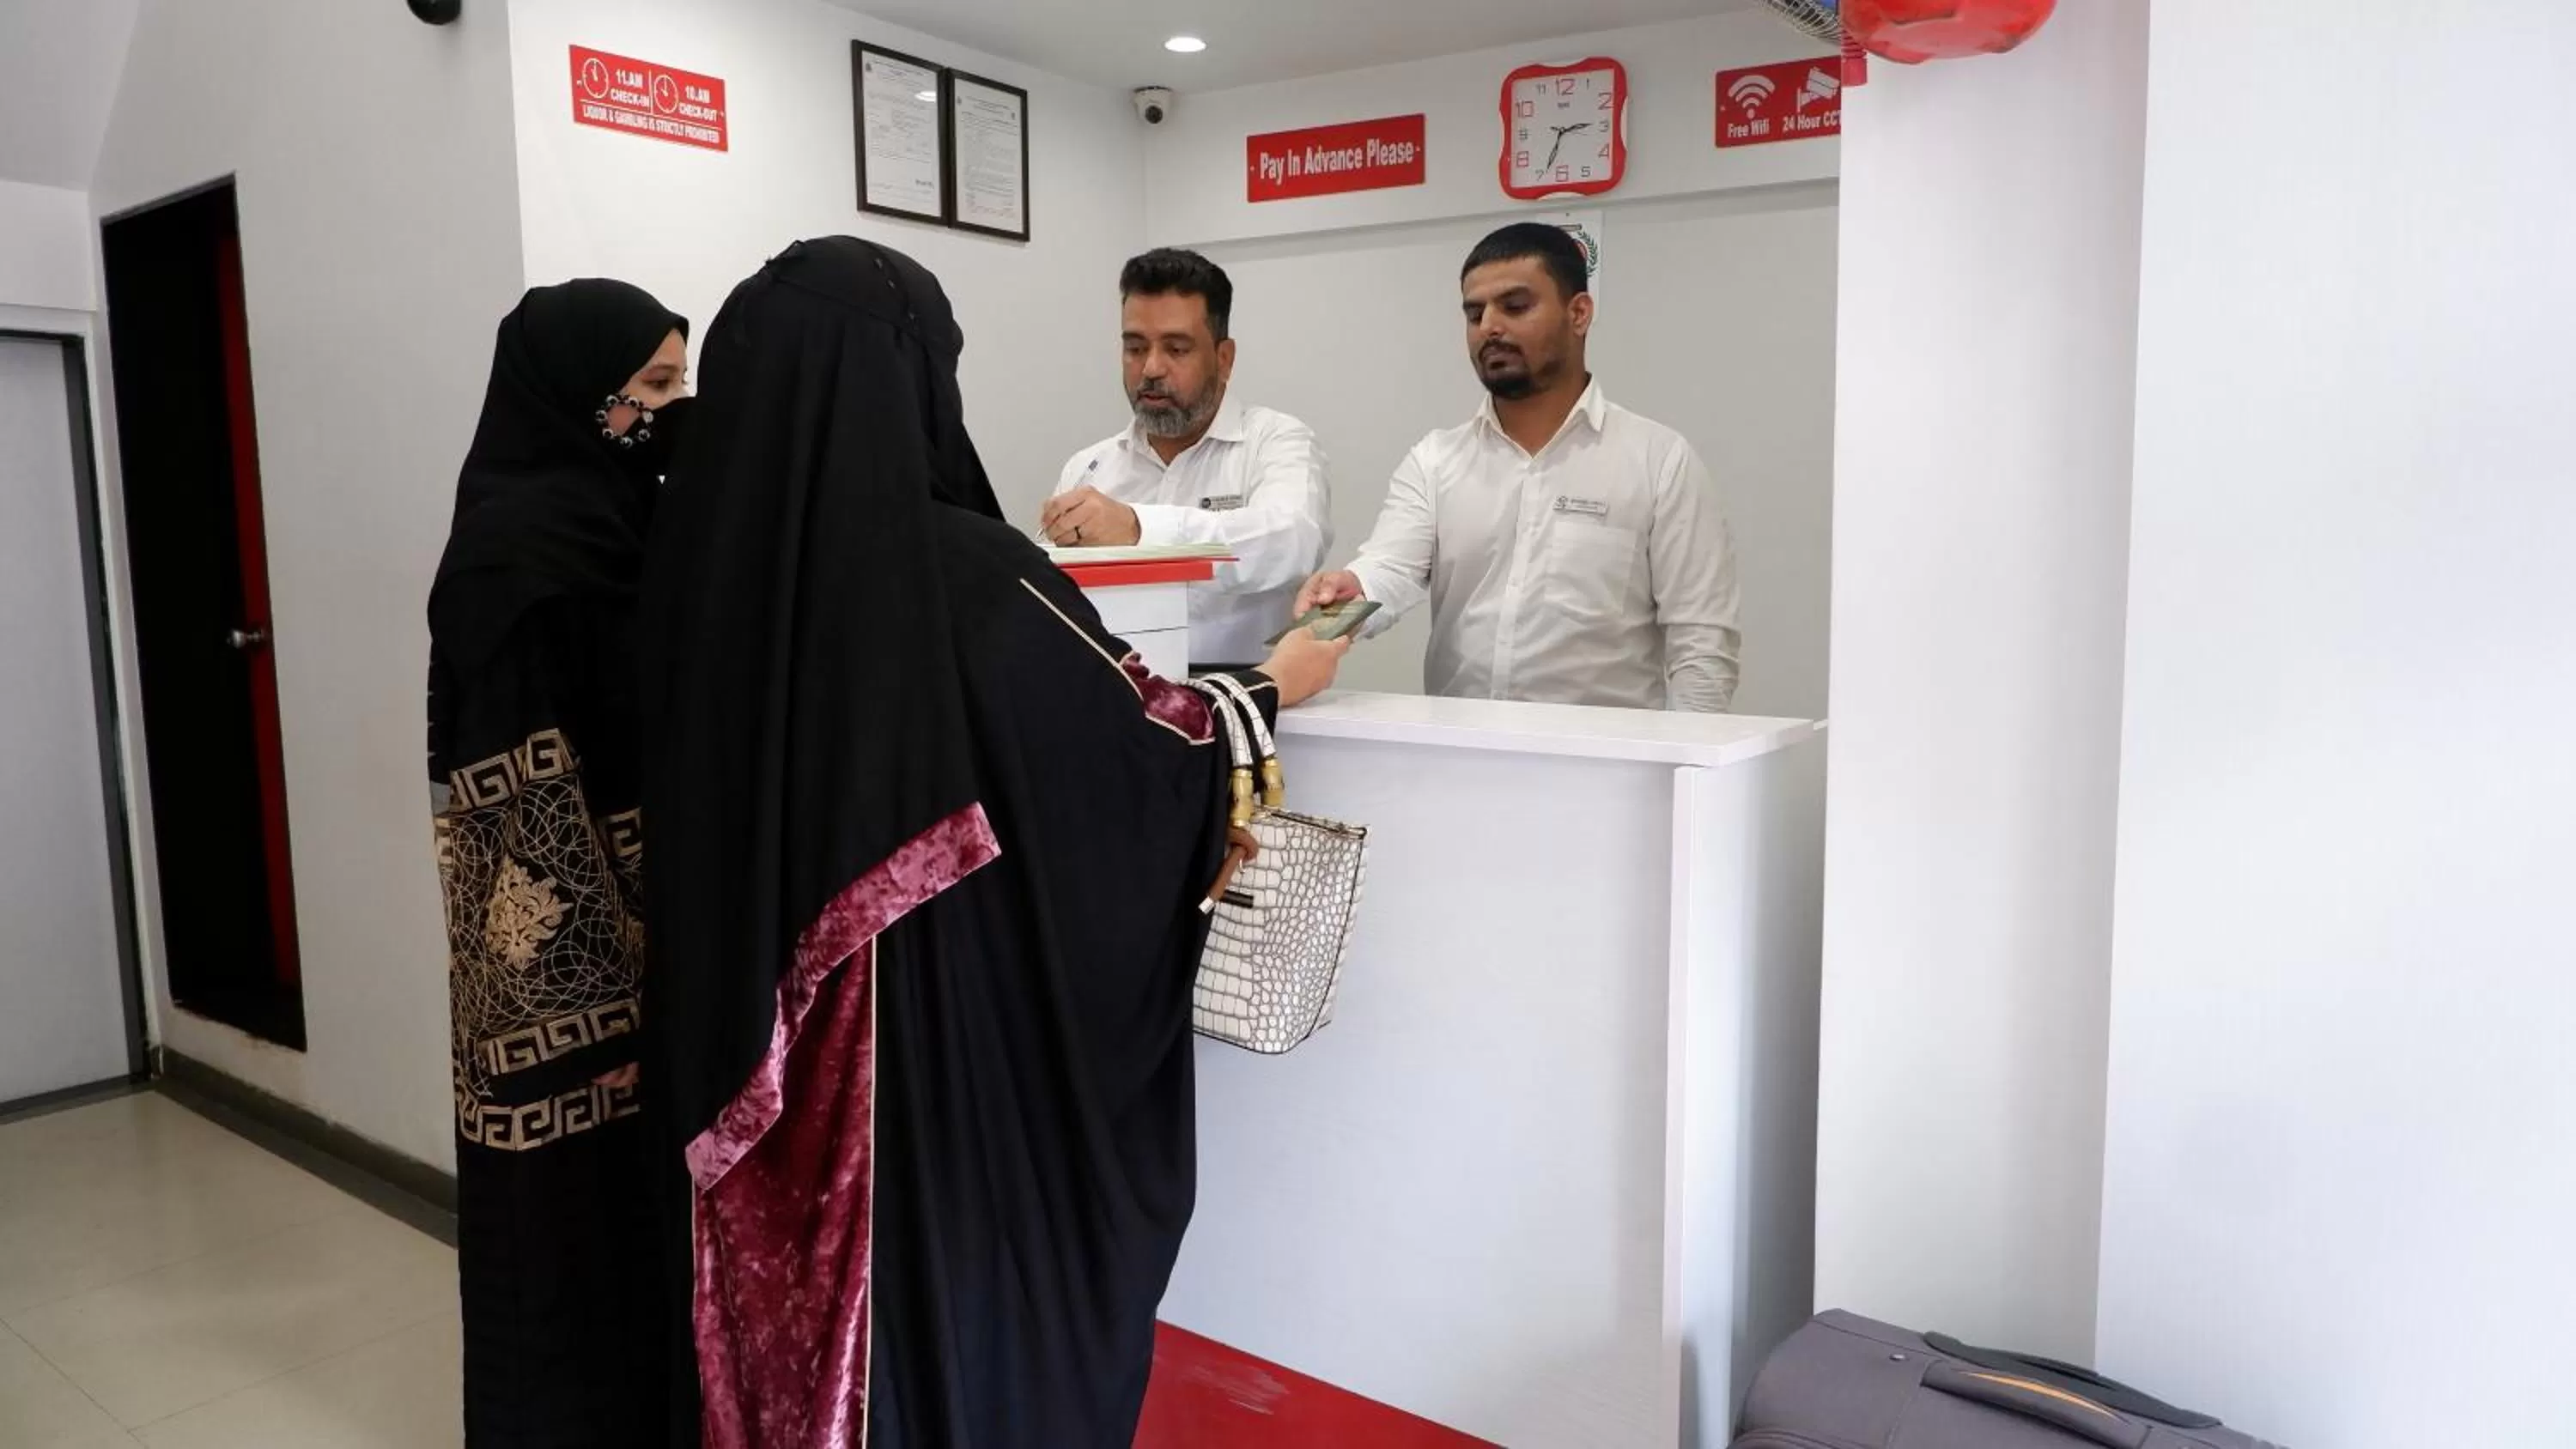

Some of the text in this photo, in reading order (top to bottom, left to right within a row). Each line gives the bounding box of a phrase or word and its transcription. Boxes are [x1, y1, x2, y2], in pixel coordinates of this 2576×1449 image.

[1536, 84, 1546, 94] 11
[1556, 78, 1575, 96] 12
[611, 88, 650, 107] CHECK-IN
[1598, 92, 1613, 110] 2
[678, 103, 717, 121] CHECK-OUT
[1516, 100, 1534, 118] 10
[1599, 119, 1609, 132] 3
[1728, 118, 1770, 138] Free Wifi
[1782, 115, 1795, 132] 24
[1797, 113, 1820, 130] Hour
[1516, 151, 1529, 167] 8
[1598, 144, 1610, 160] 4
[1260, 138, 1414, 185] Pay In Advance Please
[1556, 165, 1569, 182] 6
[1581, 166, 1591, 178] 5
